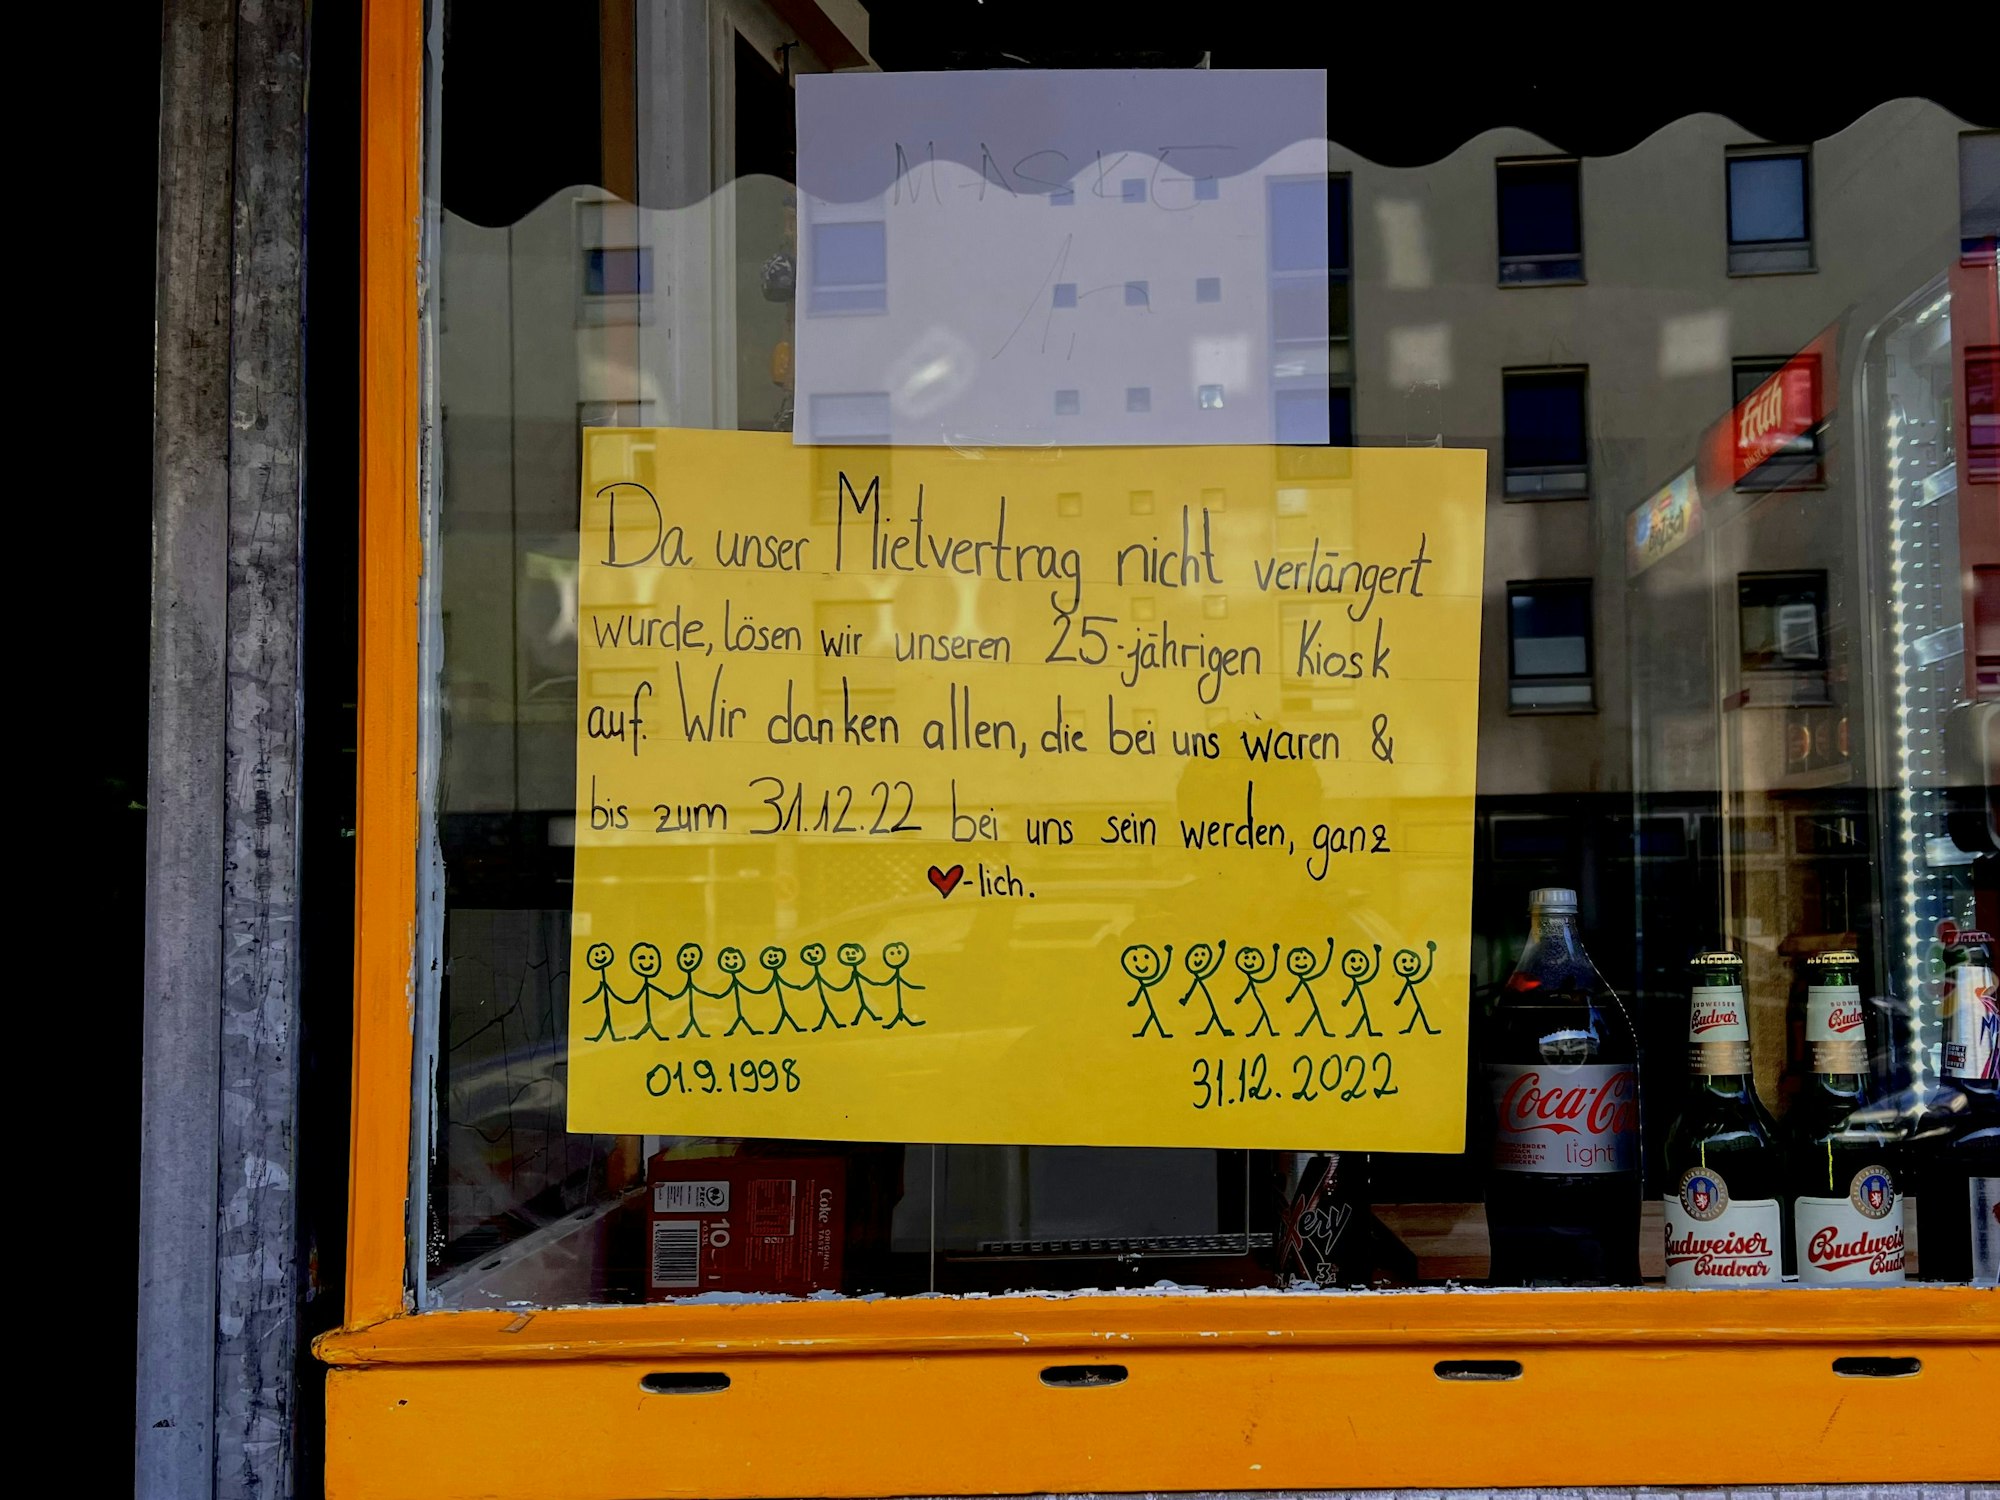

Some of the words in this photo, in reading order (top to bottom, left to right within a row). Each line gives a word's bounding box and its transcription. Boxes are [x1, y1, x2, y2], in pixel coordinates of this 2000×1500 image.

[894, 140, 1238, 212] MASKE
[596, 481, 694, 569] Da
[715, 527, 810, 571] unser
[836, 470, 1082, 616] Mietvertrag
[1116, 503, 1225, 588] nicht
[1253, 532, 1433, 623] verlängert
[592, 604, 714, 657] wurde,
[724, 598, 802, 652] lösen
[820, 624, 864, 658] wir
[894, 629, 1012, 663] unseren
[1044, 613, 1262, 705] 25-jährigen
[1296, 617, 1391, 680] Kiosk
[586, 680, 653, 757] auf.
[674, 660, 747, 743] Wir
[766, 677, 900, 746] danken
[922, 682, 1028, 759] allen,
[1040, 694, 1088, 755] die
[1108, 694, 1157, 756] bei
[1172, 728, 1221, 760] uns
[1240, 727, 1340, 764] waren
[1371, 713, 1395, 765] &
[590, 775, 630, 831] bis
[652, 803, 729, 833] zum
[748, 776, 922, 835] 31.12.22
[951, 779, 999, 843] bei
[1025, 815, 1074, 847] uns
[1100, 812, 1157, 846] sein
[1180, 780, 1295, 856] werden,
[1305, 822, 1392, 881] ganz
[1691, 1009, 1740, 1030] Budvar
[645, 1058, 801, 1097] 01.9.1998
[1193, 1051, 1399, 1110] 31.12.2022
[1565, 1139, 1615, 1168] light
[818, 1188, 833, 1224] Coke
[709, 1217, 731, 1248] 10
[817, 1229, 825, 1257] TASTE
[823, 1228, 832, 1272] ORIGINAL
[1694, 1254, 1770, 1277] Budvar
